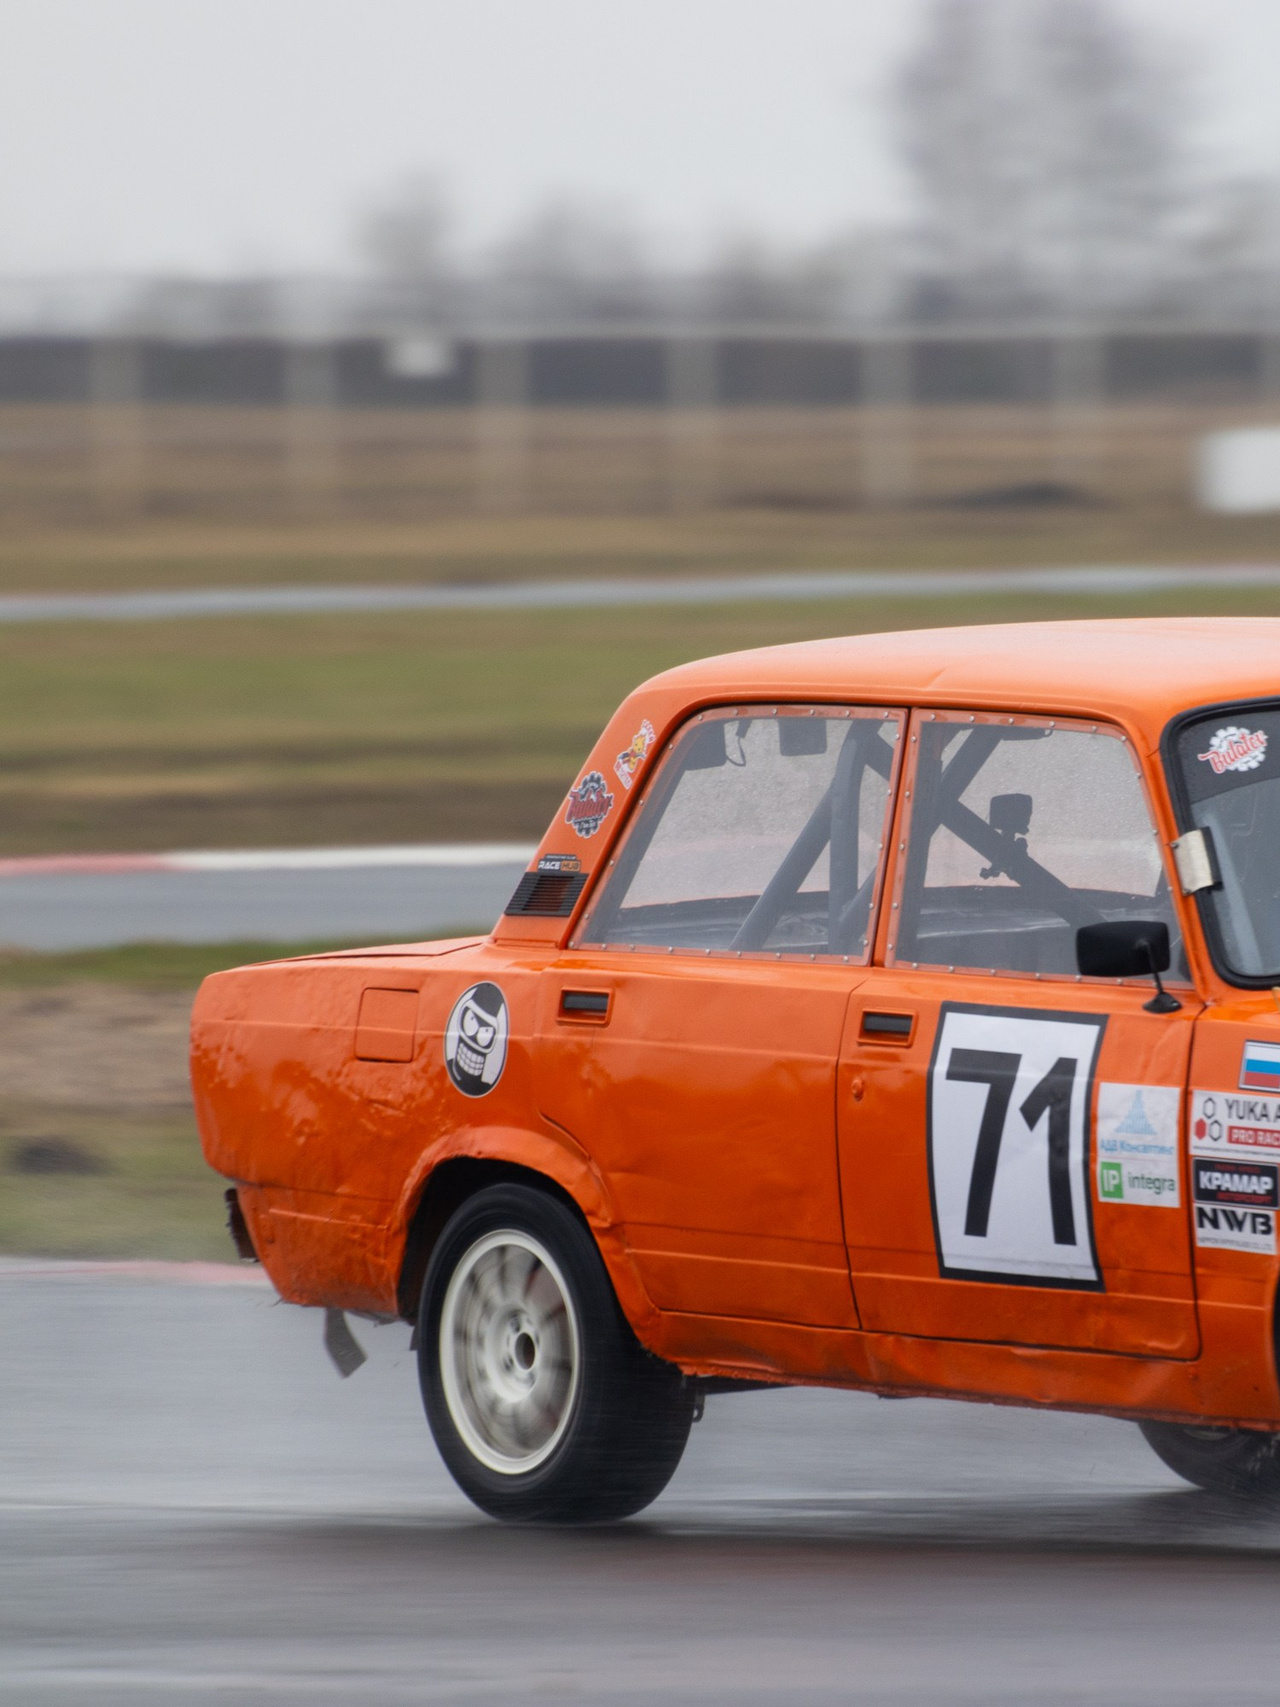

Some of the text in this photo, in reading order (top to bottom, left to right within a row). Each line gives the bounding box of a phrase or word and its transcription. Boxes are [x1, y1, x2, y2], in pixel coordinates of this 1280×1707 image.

[538, 861, 561, 870] RACE
[1225, 1098, 1270, 1122] YUKA
[945, 1047, 1078, 1247] 71
[1231, 1128, 1256, 1144] PRO
[1128, 1171, 1176, 1195] integra
[1199, 1170, 1273, 1195] КРАМАР
[1197, 1206, 1273, 1236] NWB
